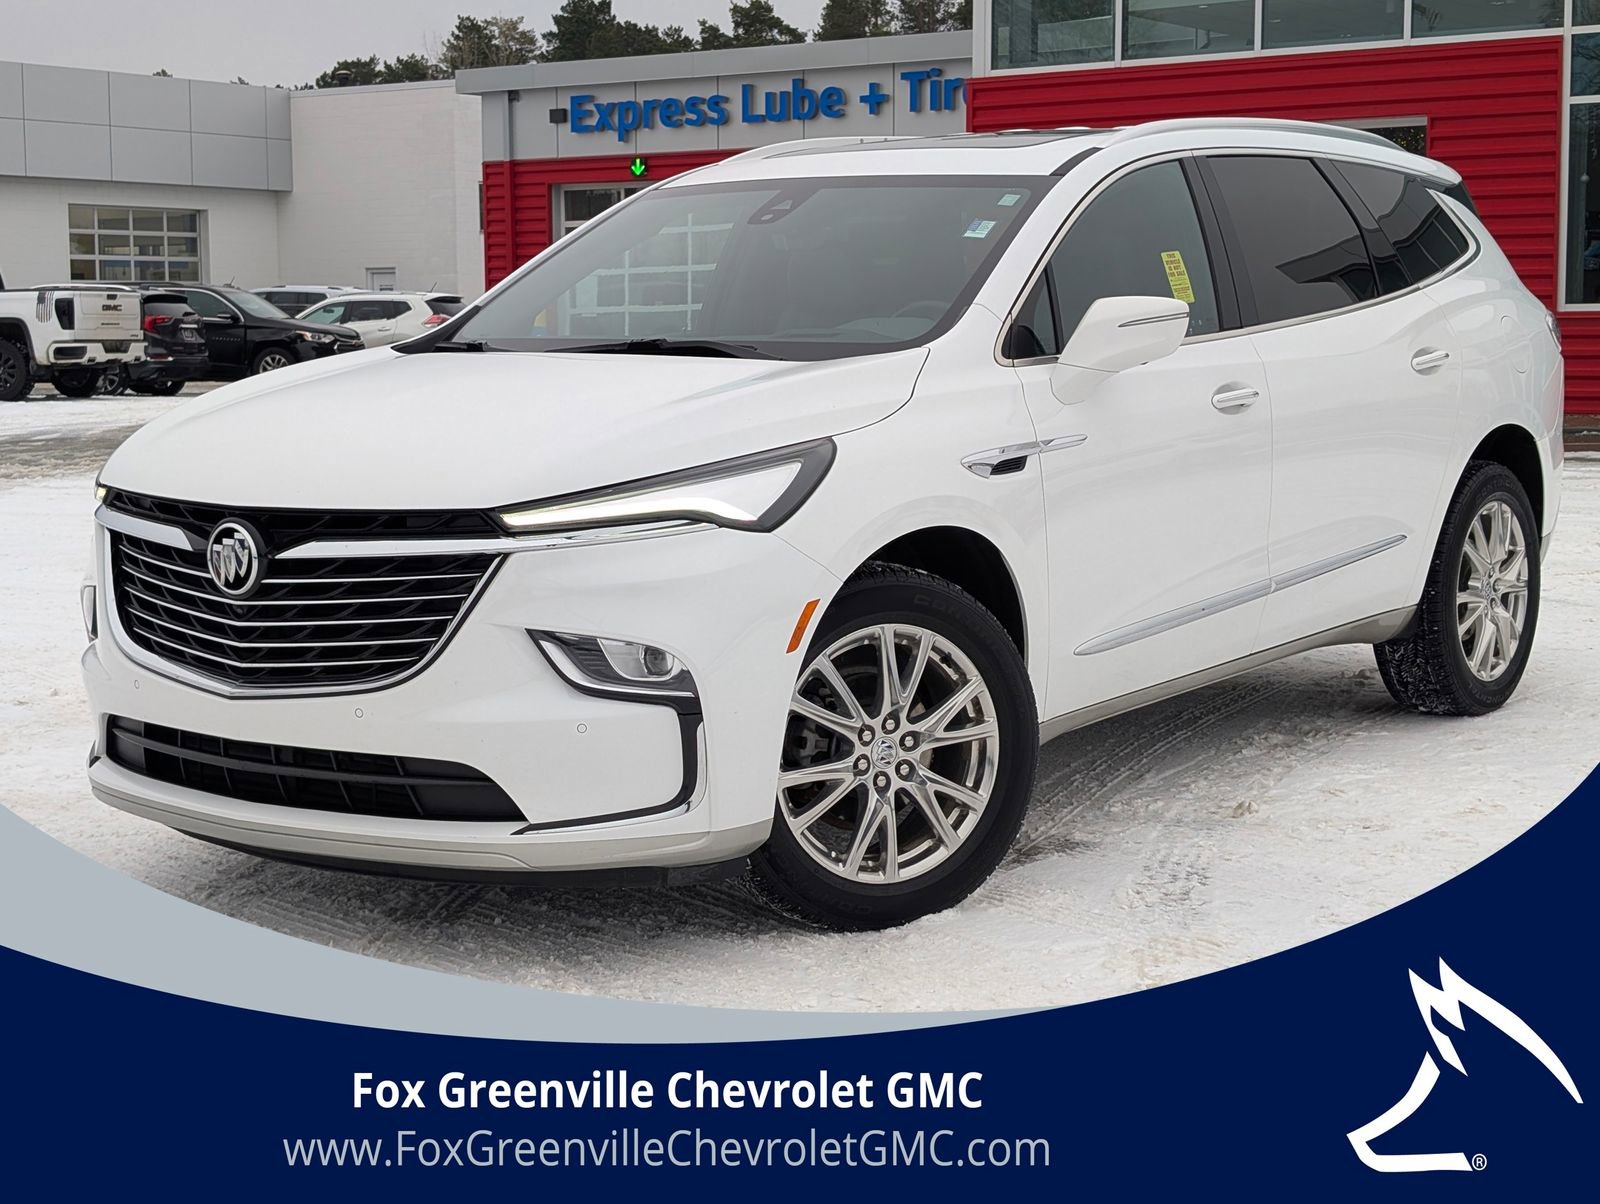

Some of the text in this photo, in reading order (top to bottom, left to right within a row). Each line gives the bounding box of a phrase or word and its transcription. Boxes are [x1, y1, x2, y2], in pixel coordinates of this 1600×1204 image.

[570, 67, 966, 142] Express Lube + Tir
[102, 304, 122, 312] GMC
